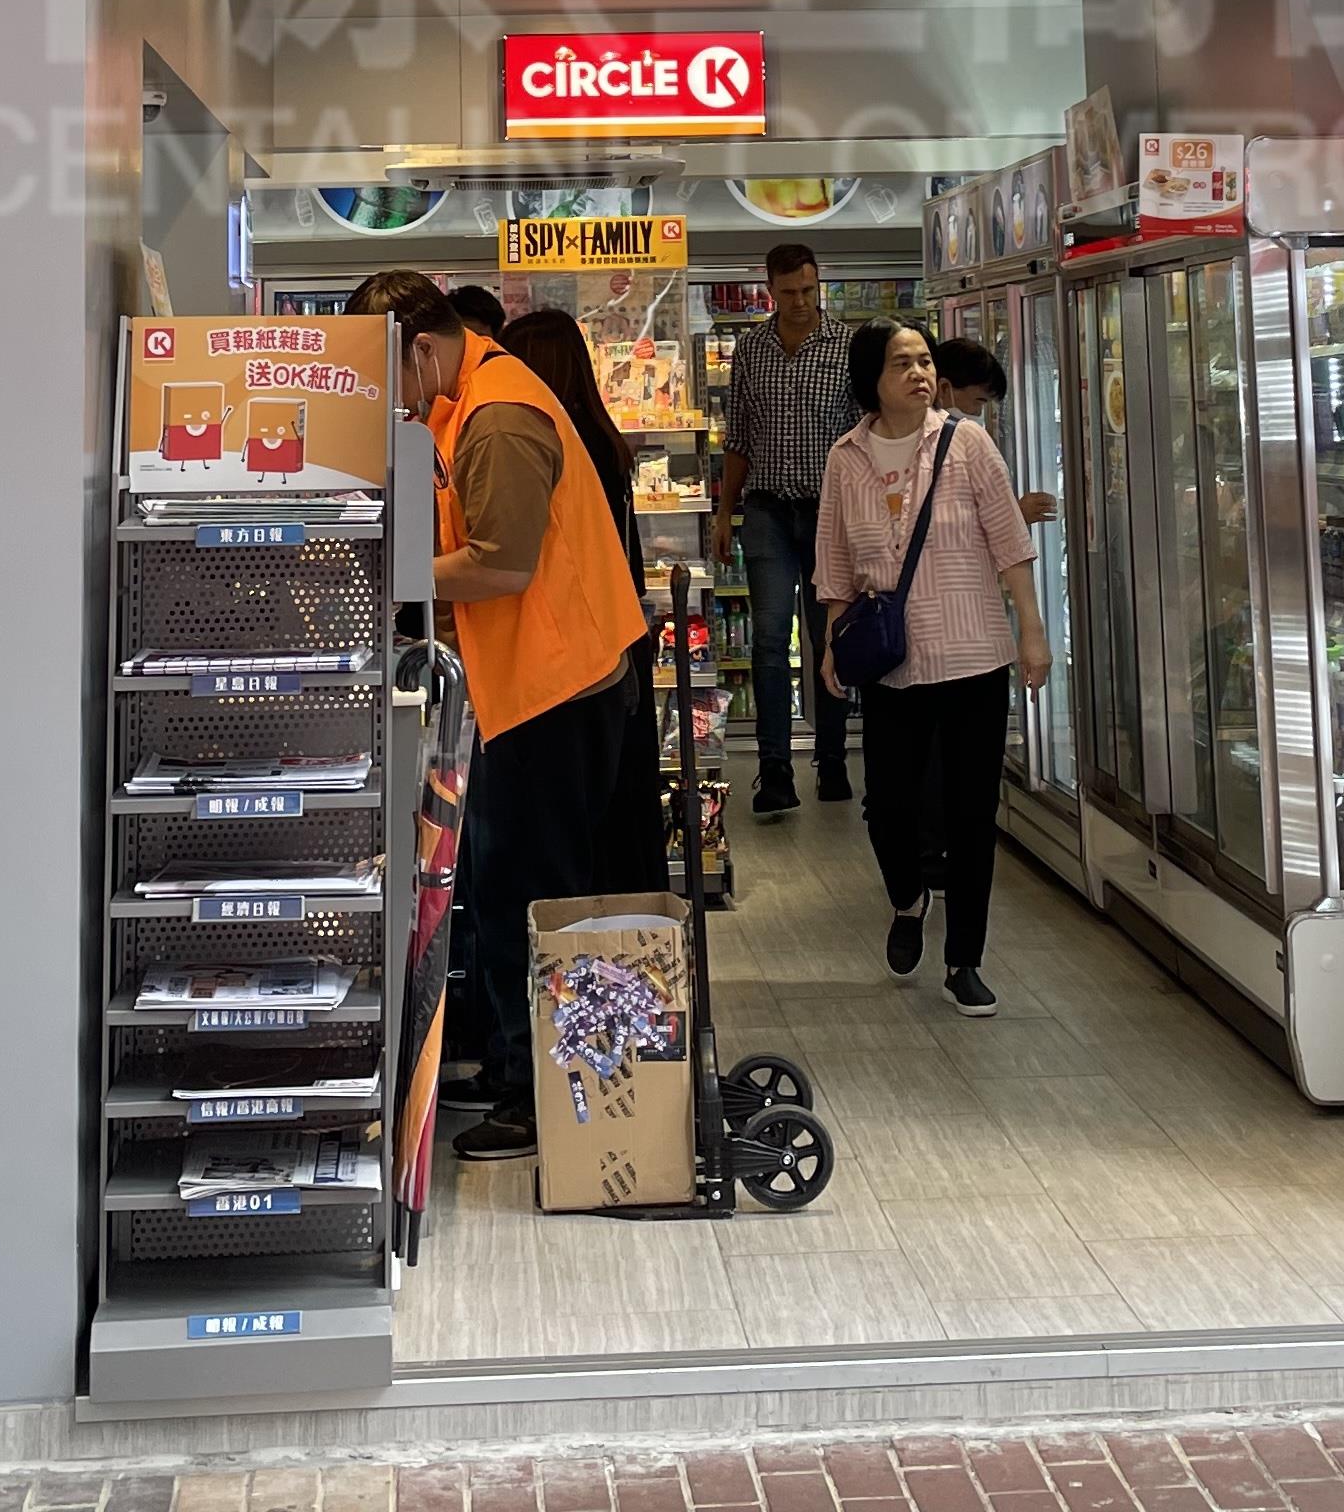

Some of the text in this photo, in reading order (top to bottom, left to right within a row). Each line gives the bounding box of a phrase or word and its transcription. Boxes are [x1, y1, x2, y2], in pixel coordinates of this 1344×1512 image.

[521, 59, 679, 98] CIRCLE
[1176, 143, 1208, 160] $26
[209, 329, 324, 354] 買報紙雜誌
[220, 527, 283, 543] 東方日報
[215, 676, 278, 691] 星島日報
[215, 1194, 273, 1211] 香港01
